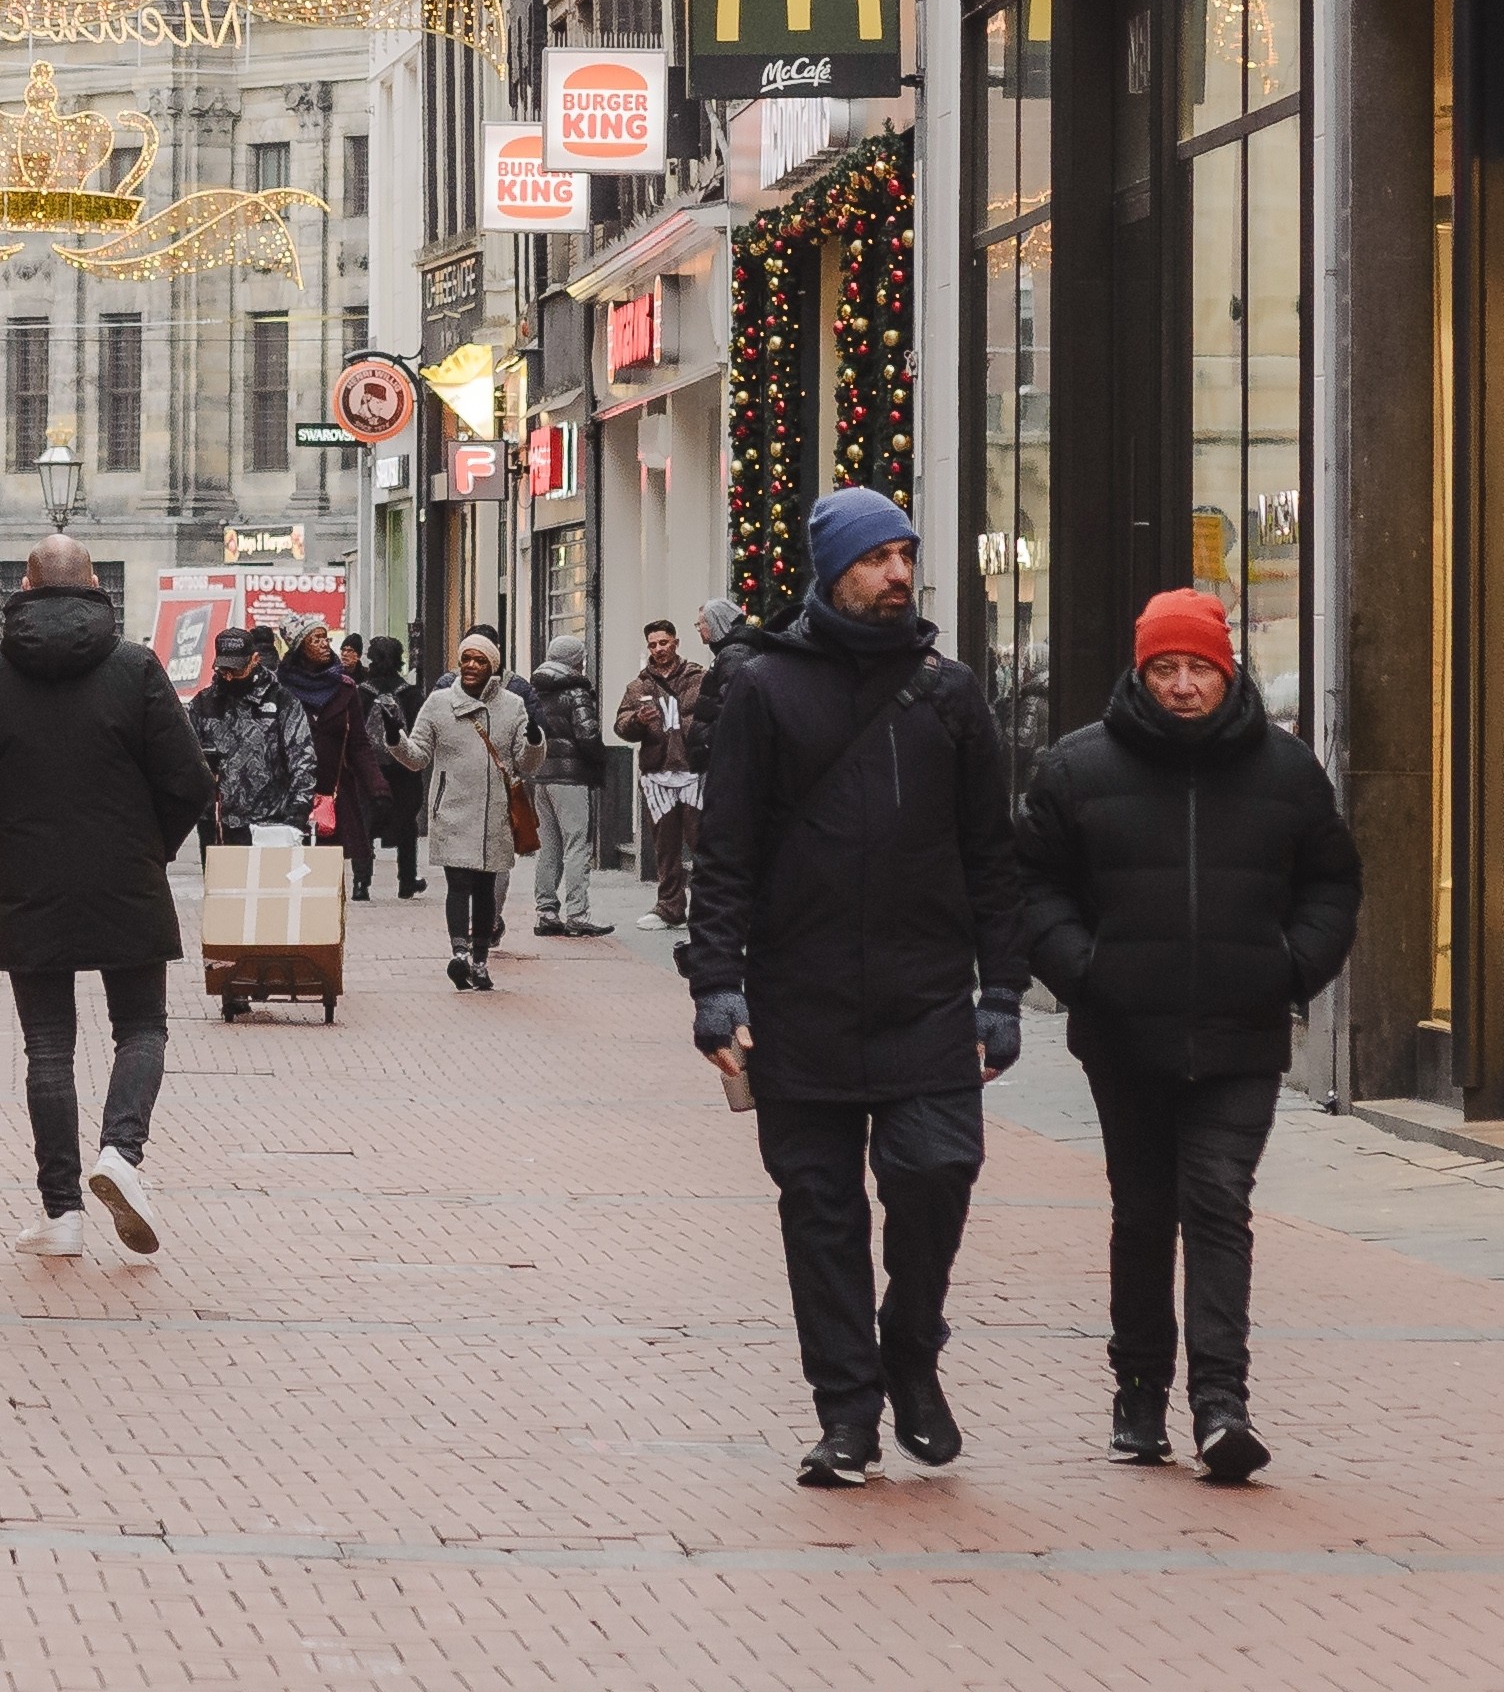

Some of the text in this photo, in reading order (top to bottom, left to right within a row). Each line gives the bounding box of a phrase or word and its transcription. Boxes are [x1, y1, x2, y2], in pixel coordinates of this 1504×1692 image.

[760, 57, 833, 93] McCafé
[562, 92, 649, 112] BURGER
[562, 112, 649, 140] KING
[497, 179, 573, 203] KING
[246, 573, 336, 593] HOTDOGS
